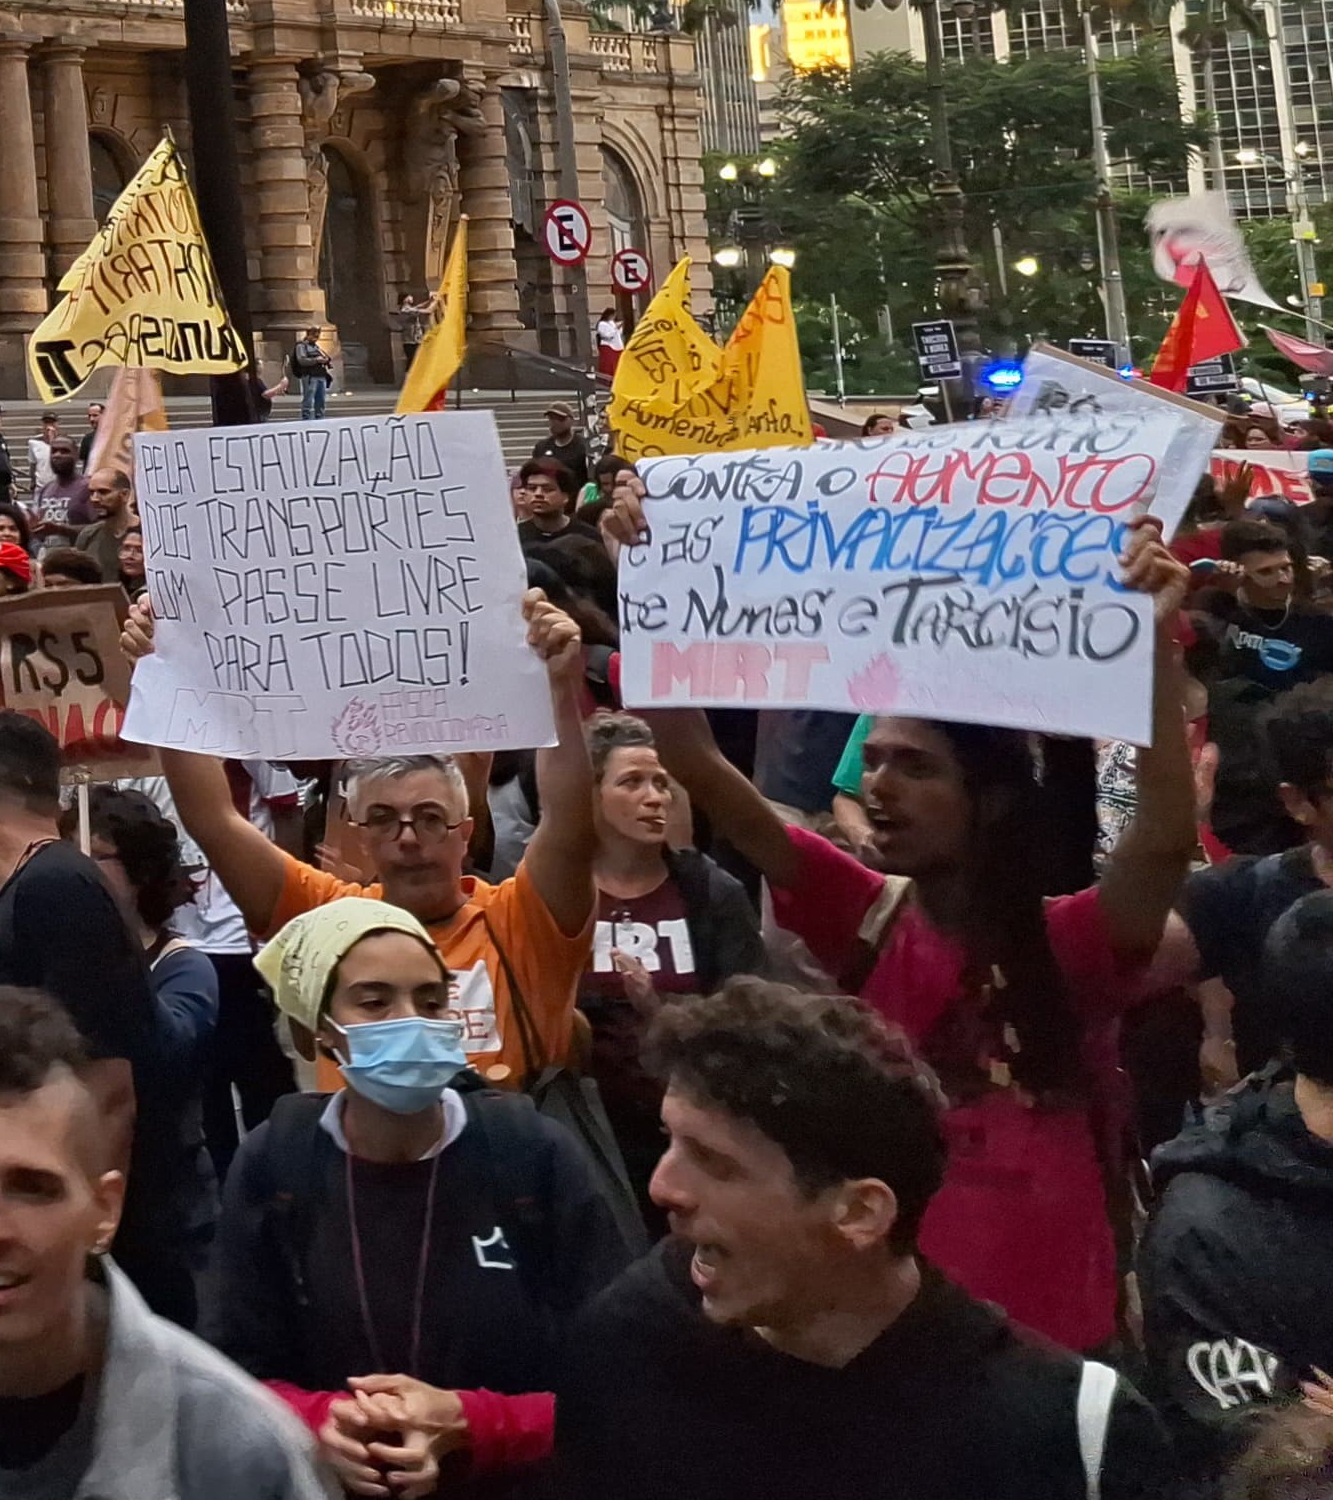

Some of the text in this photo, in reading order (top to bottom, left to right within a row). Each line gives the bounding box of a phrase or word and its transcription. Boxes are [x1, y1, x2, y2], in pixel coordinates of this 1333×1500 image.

[141, 441, 196, 495] PELA
[209, 415, 444, 494] ESTATIZAÇÃO
[145, 486, 476, 561] DOS TRANSPORTES
[213, 562, 347, 626] PASSE
[373, 555, 484, 618] LIVRE
[204, 621, 471, 693] PARA TODOS!
[651, 640, 831, 700] MRT
